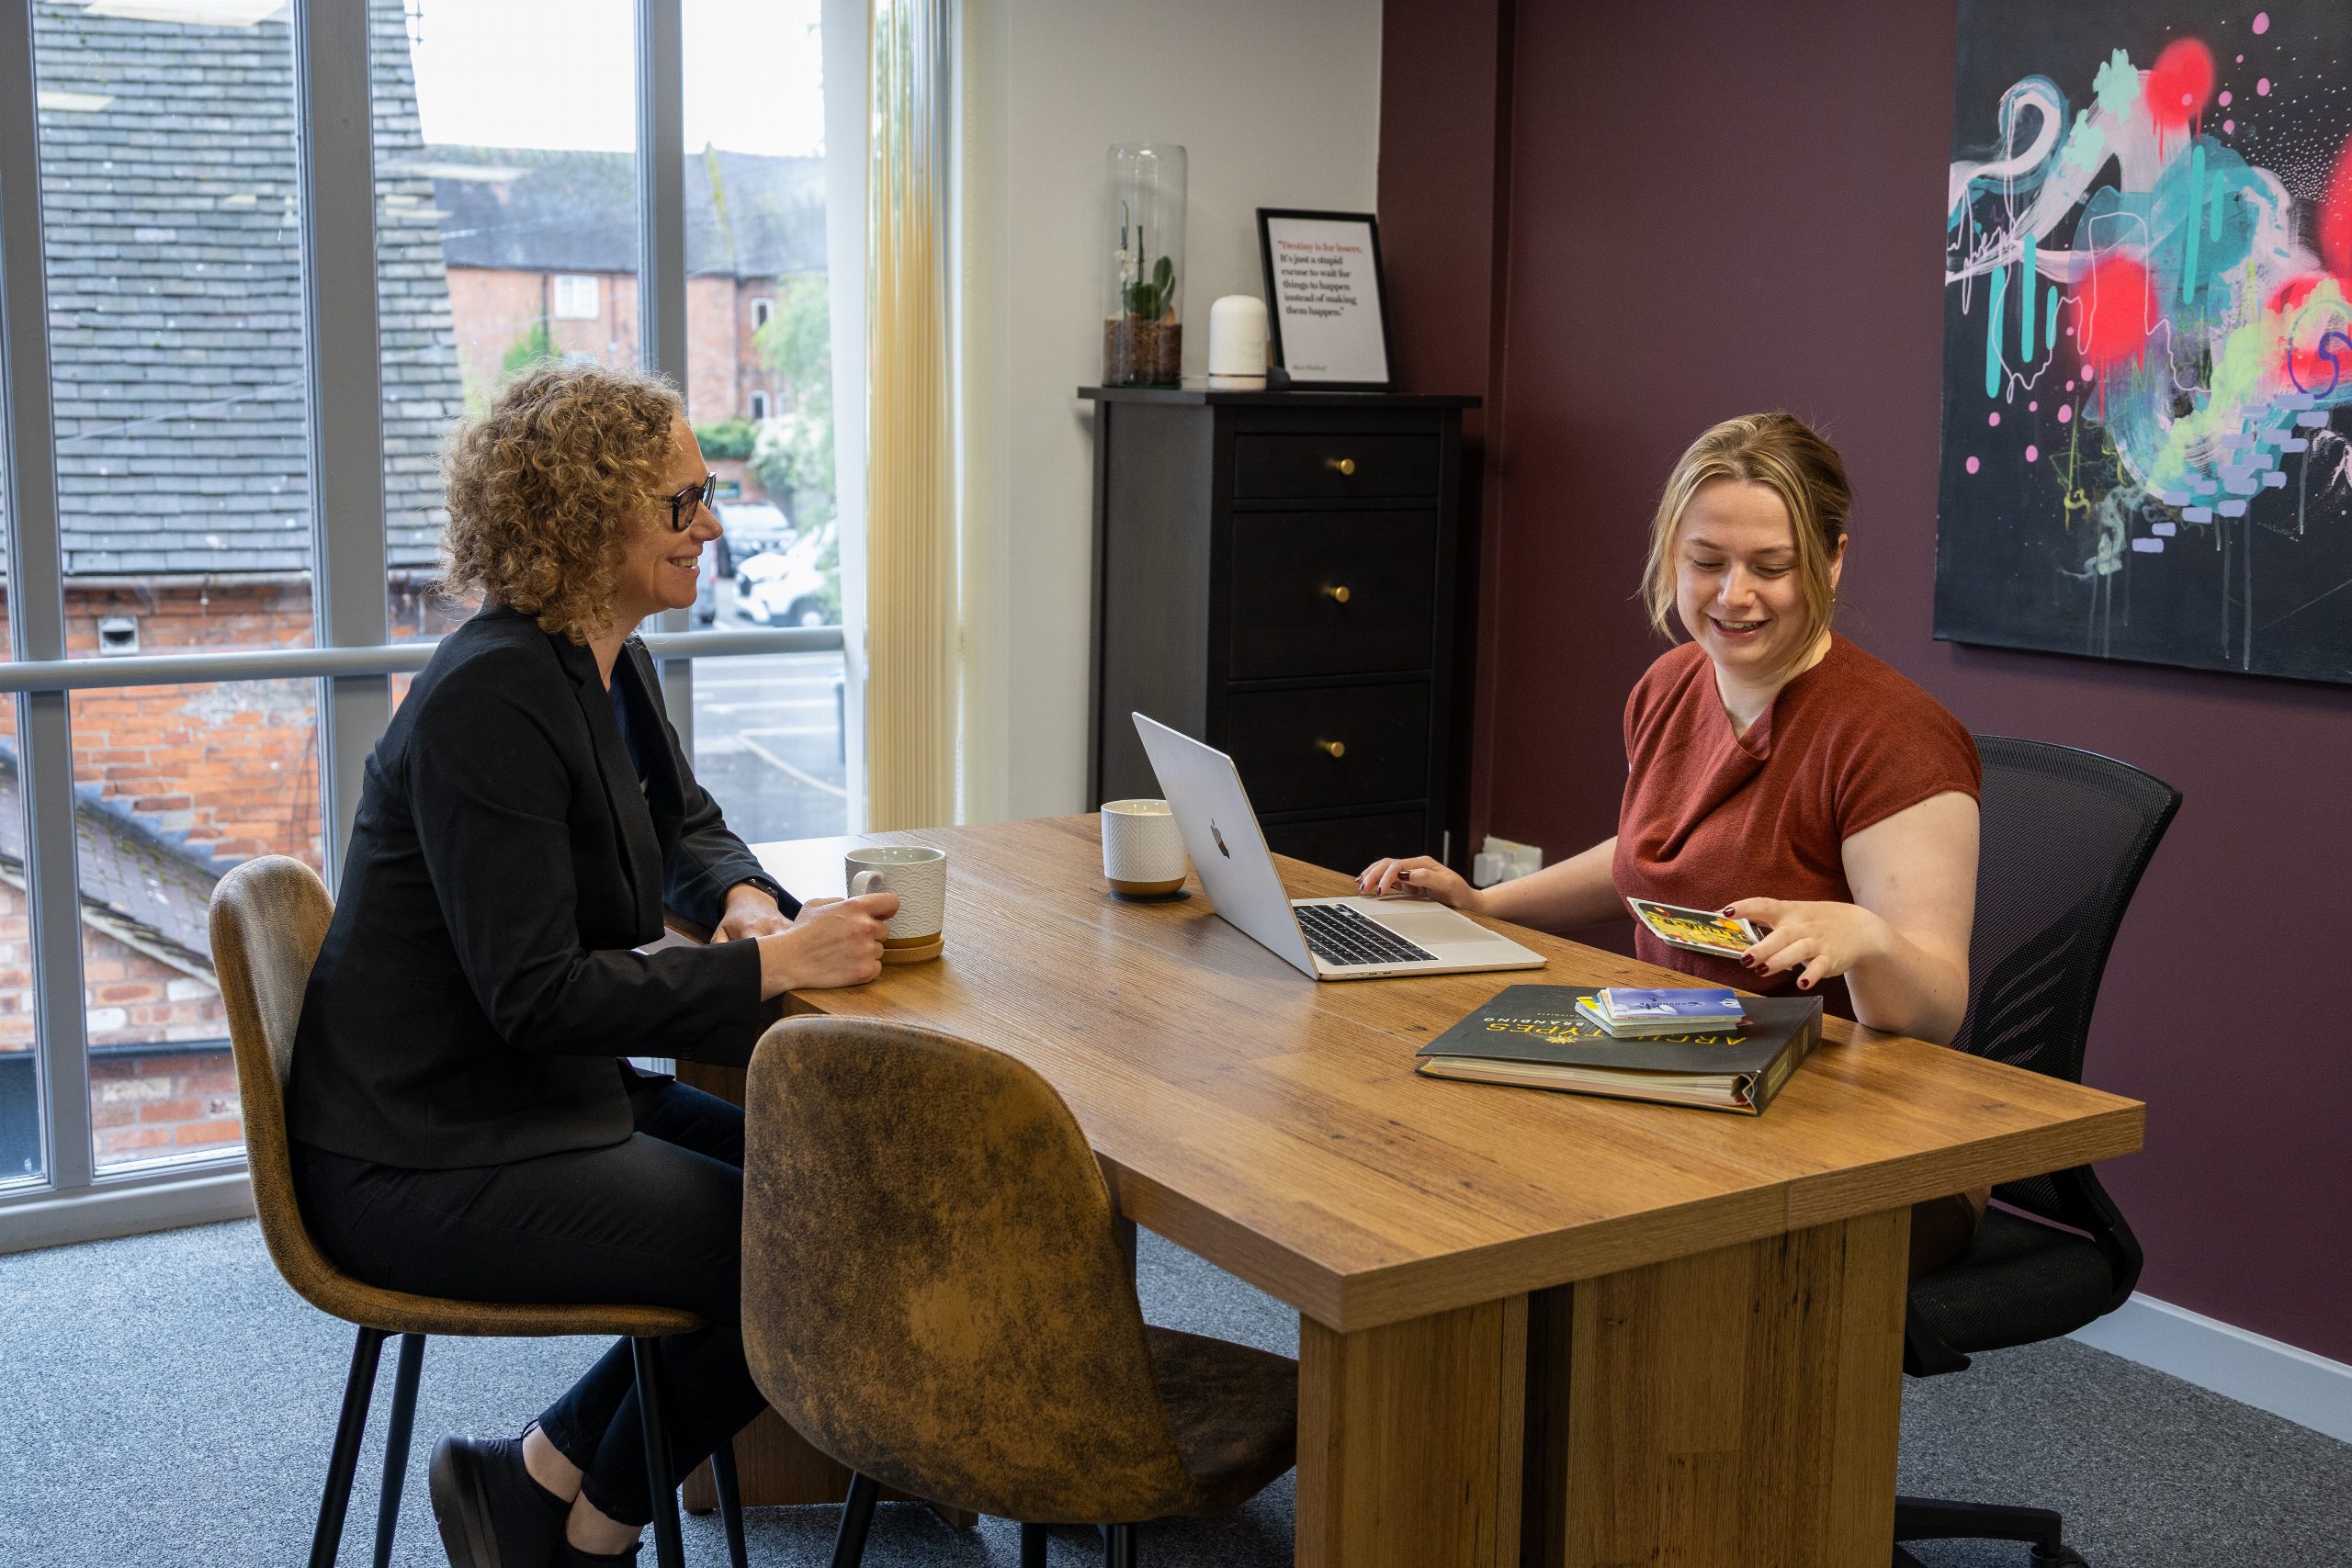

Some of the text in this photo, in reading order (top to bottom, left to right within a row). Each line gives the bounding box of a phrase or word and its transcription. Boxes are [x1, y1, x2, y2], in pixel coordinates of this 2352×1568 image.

[1314, 242, 1322, 251] is
[1323, 243, 1335, 252] for
[1336, 243, 1363, 254] losers.
[1280, 254, 1292, 263] It's
[1294, 254, 1309, 265] just
[1317, 255, 1343, 266] stupid
[1281, 268, 1308, 276] excuse
[1320, 269, 1337, 277] wait
[1339, 268, 1351, 278] for
[1283, 278, 1351, 292] things to happen
[1284, 293, 1357, 306] instead of making
[1286, 304, 1306, 314] them
[1484, 1017, 1584, 1026] BRANDING
